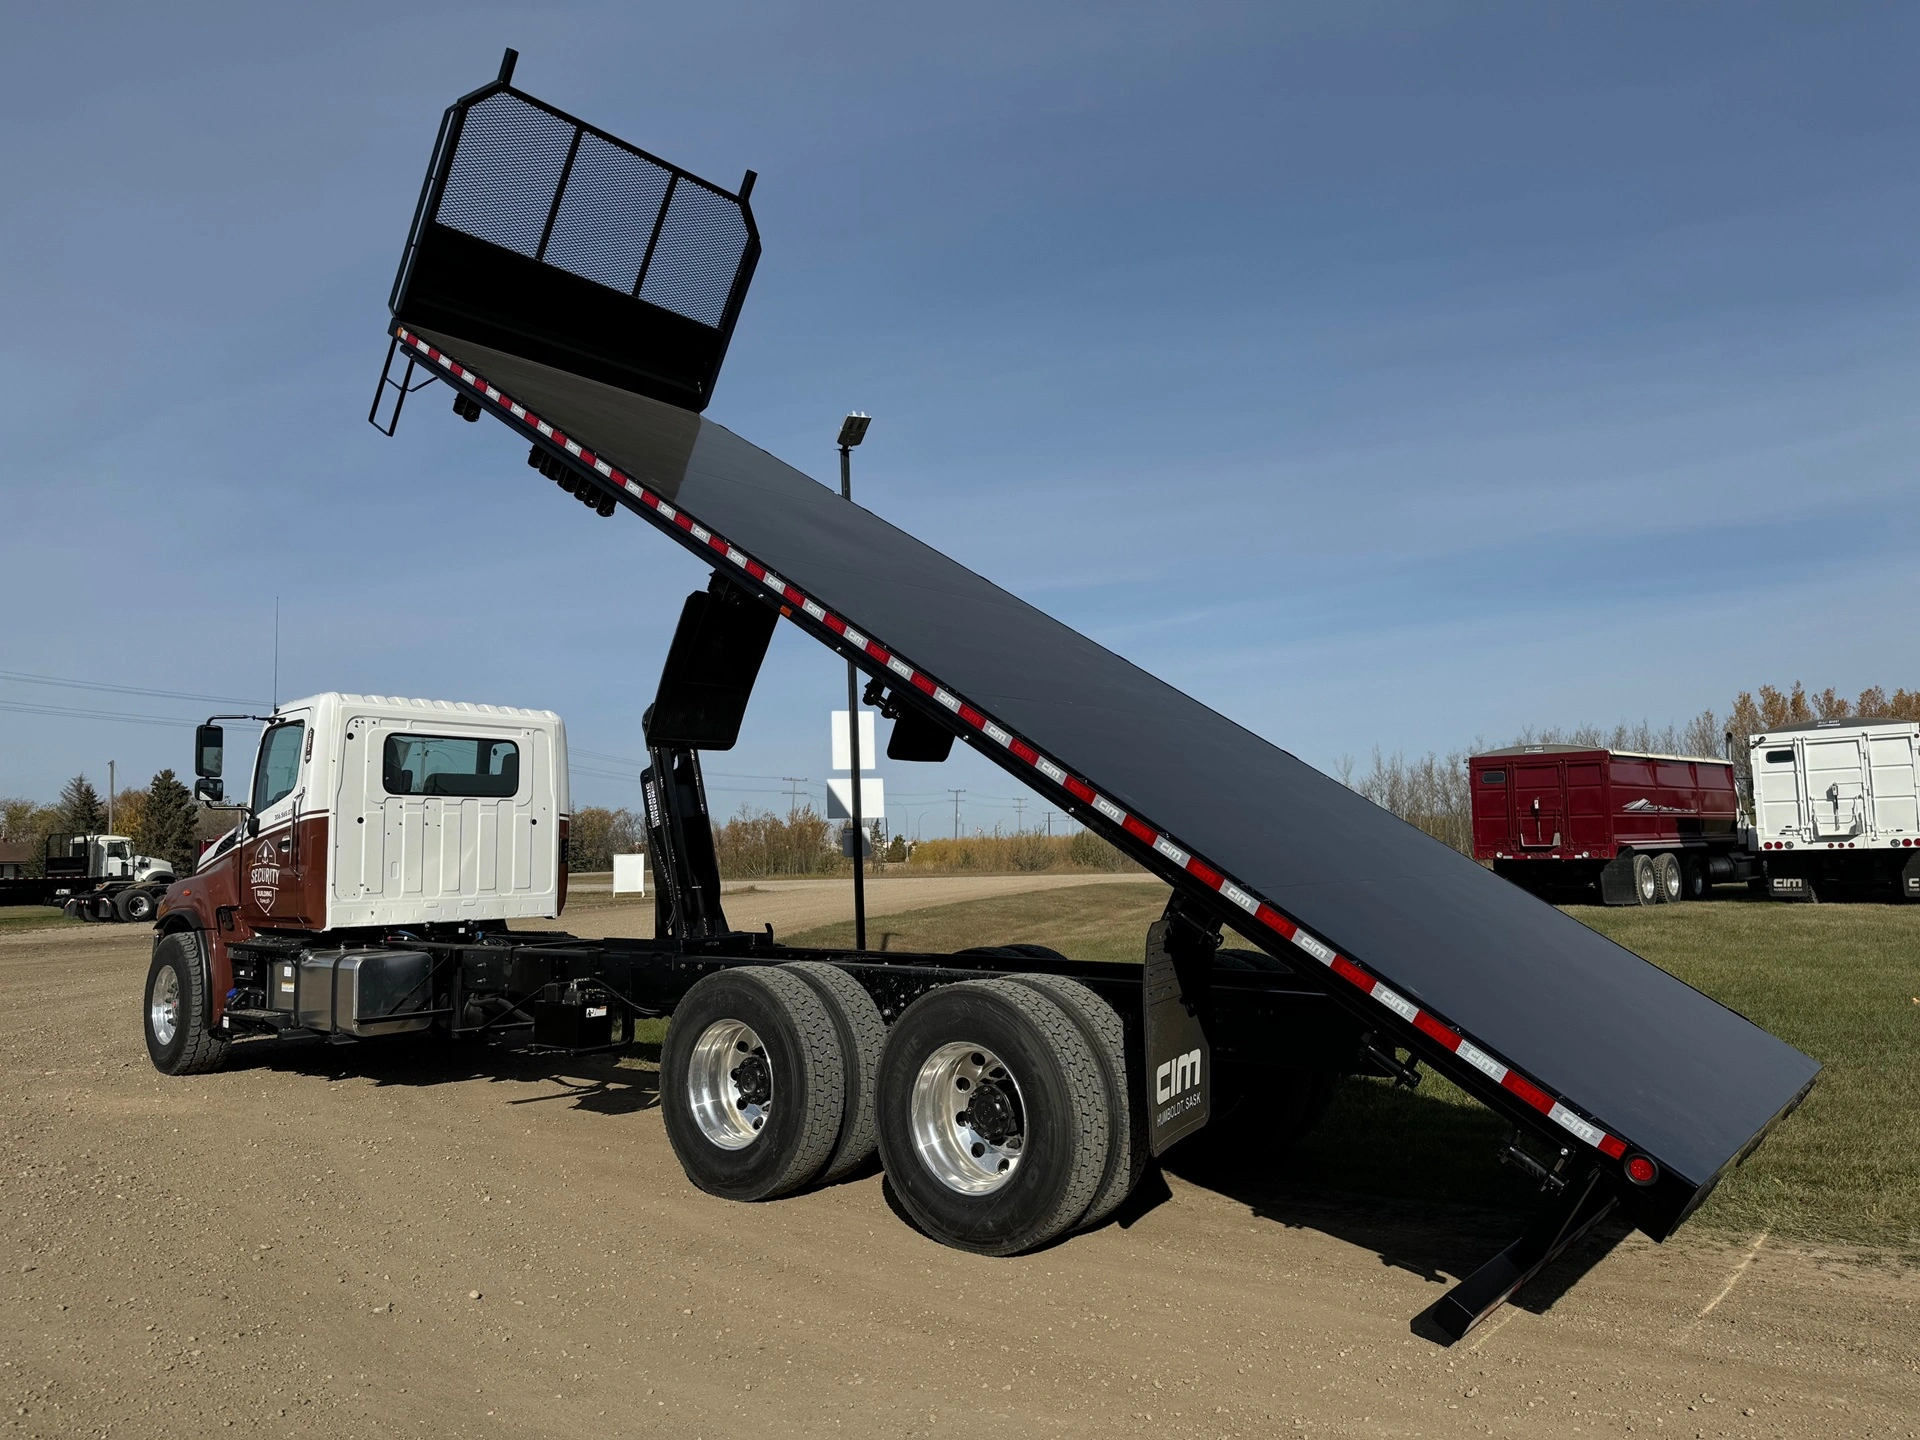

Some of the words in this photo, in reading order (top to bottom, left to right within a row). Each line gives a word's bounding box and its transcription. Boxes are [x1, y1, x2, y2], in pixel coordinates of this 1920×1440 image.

[251, 867, 280, 885] SECURITY
[1157, 1049, 1201, 1105] CIM
[1186, 1092, 1201, 1110] SASK
